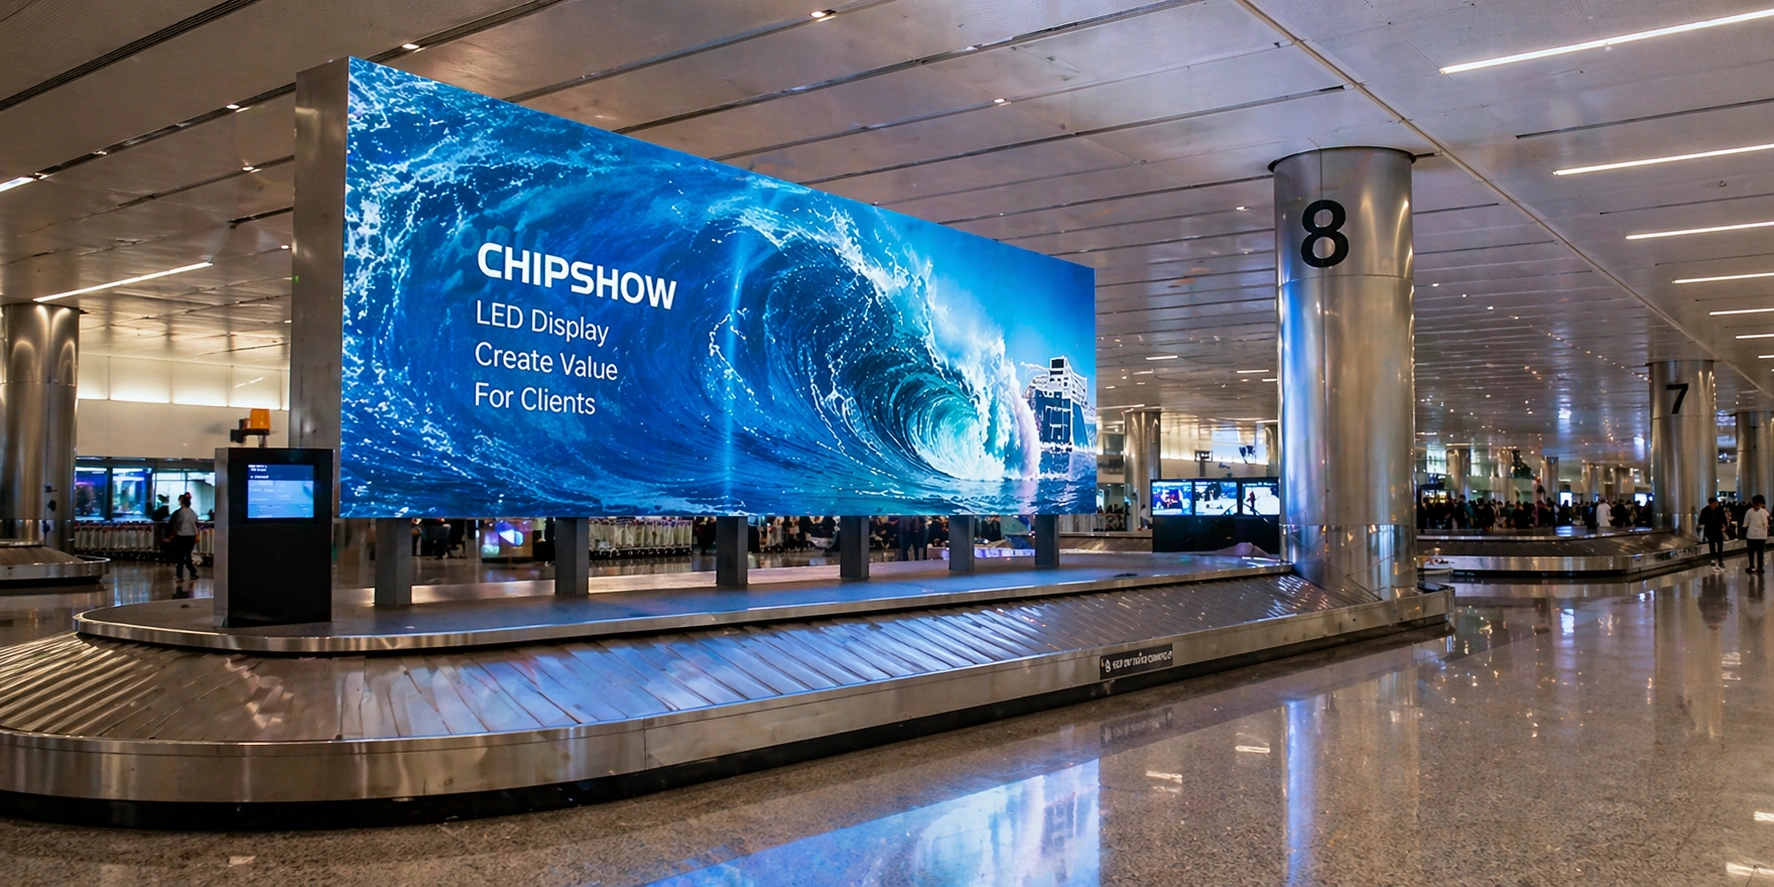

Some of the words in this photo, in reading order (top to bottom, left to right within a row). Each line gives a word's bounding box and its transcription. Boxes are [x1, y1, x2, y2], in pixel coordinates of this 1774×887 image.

[1301, 199, 1350, 268] 8
[477, 242, 677, 310] CHIPSHOW
[476, 299, 524, 329] LED
[531, 308, 609, 347] Display
[475, 342, 553, 373] Create
[560, 352, 618, 380] Value
[475, 382, 514, 409] For
[521, 386, 596, 415] Clients
[1666, 383, 1689, 415] 7
